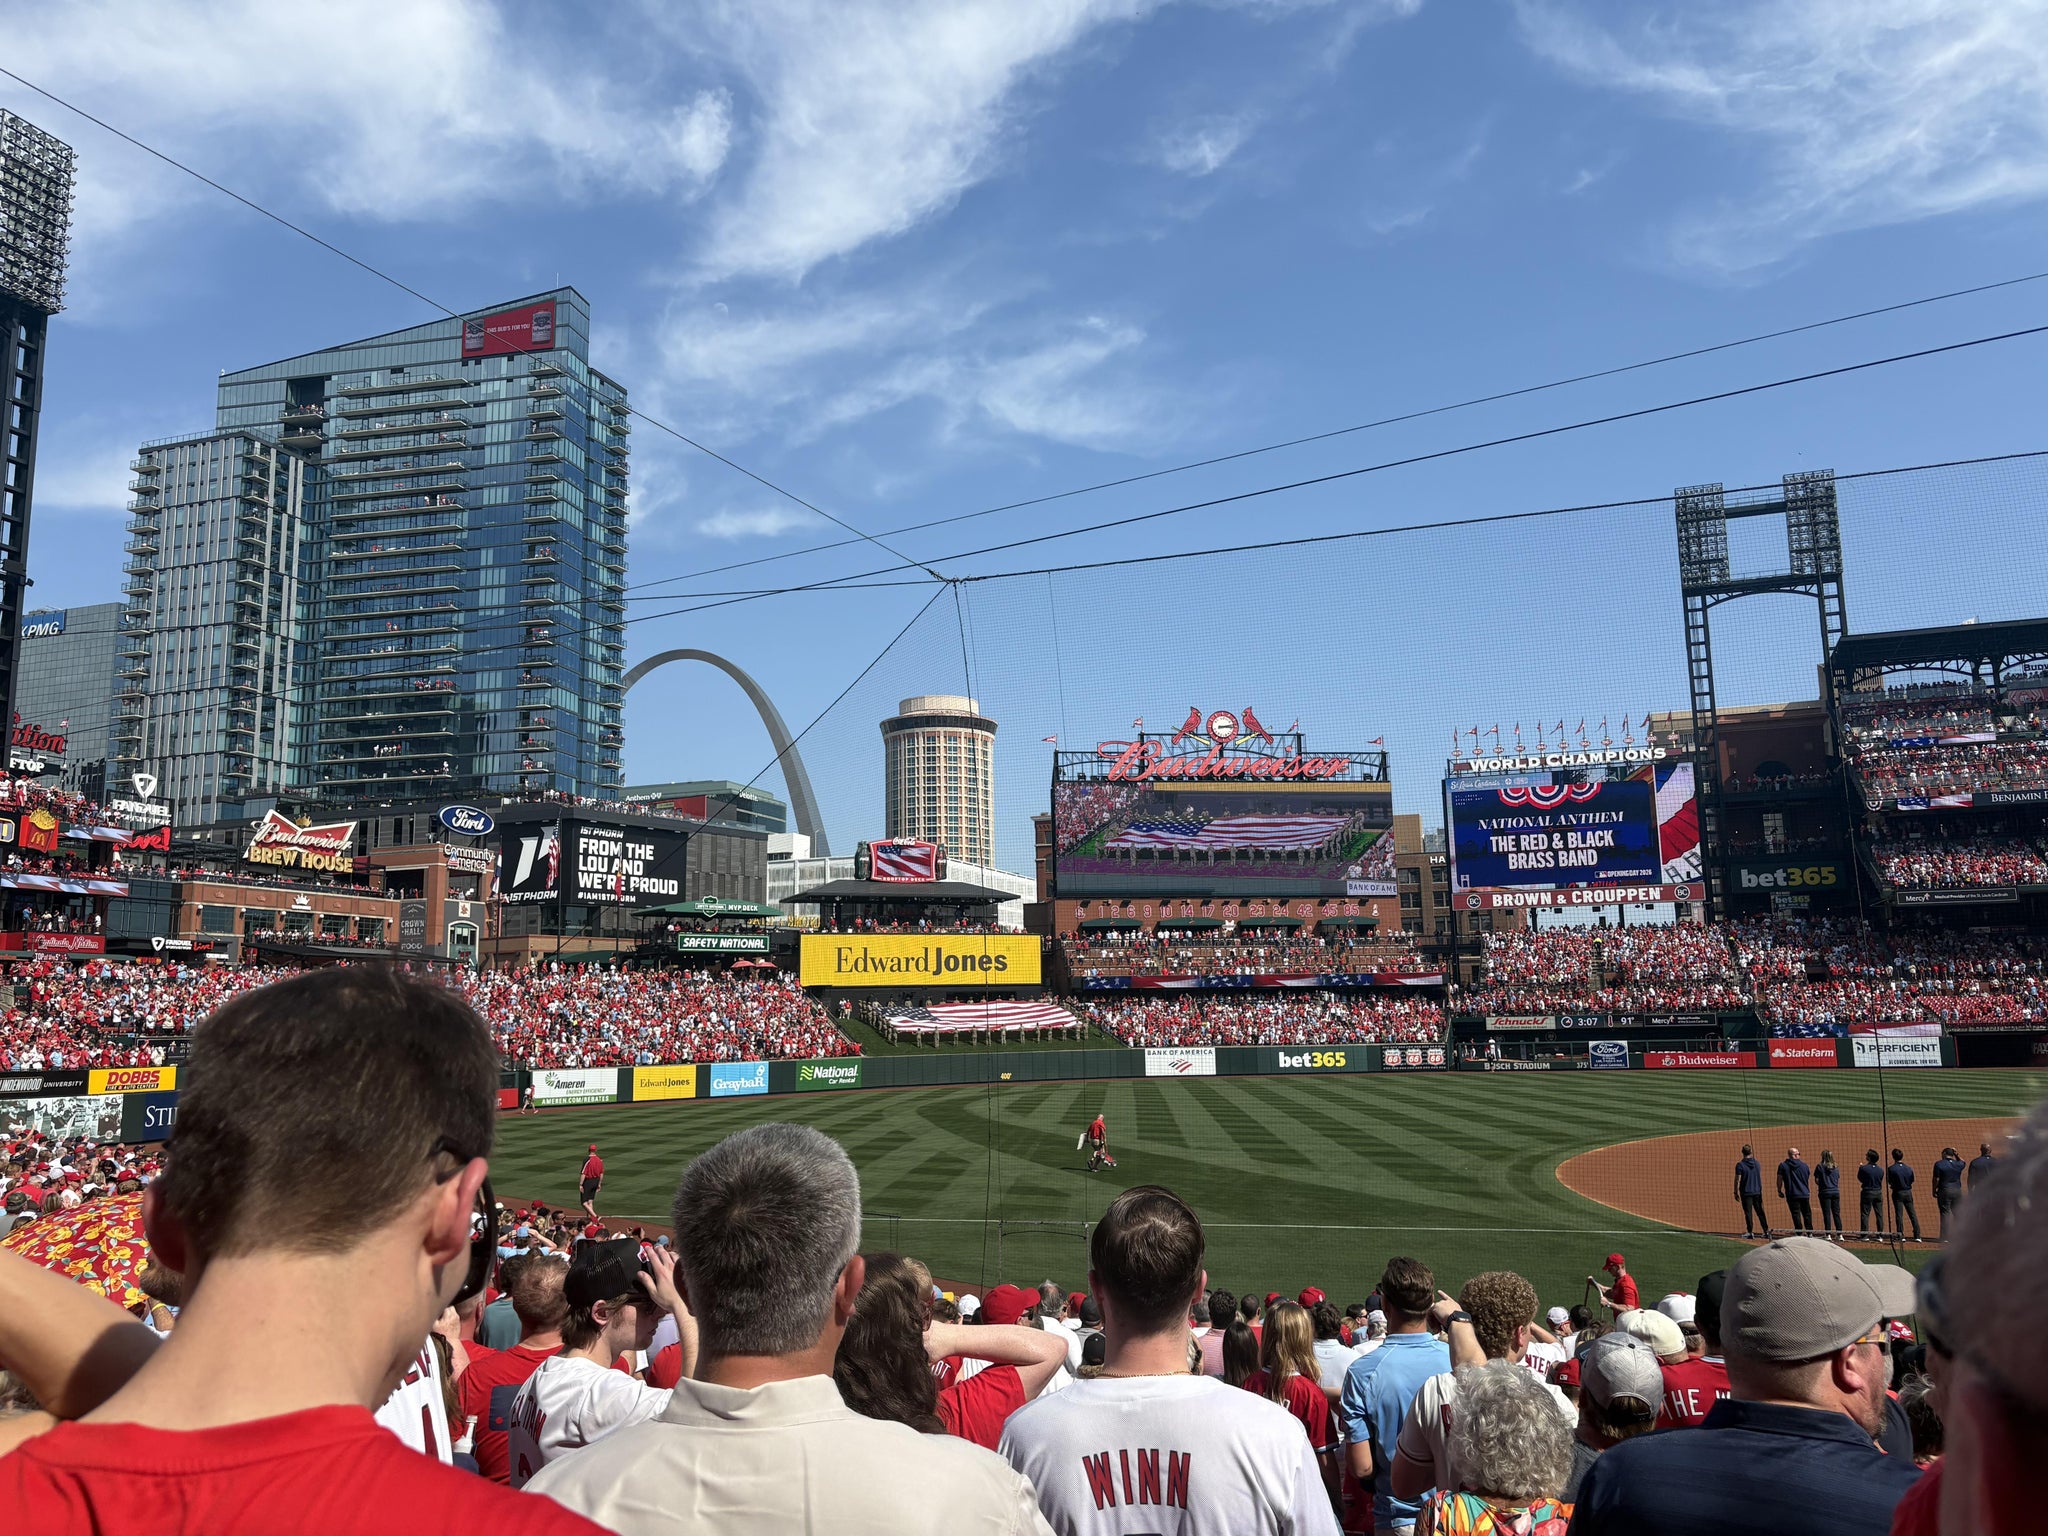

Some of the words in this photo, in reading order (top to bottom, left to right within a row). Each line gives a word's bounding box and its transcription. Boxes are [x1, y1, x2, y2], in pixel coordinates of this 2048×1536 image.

[1097, 740, 1350, 782] Budweiser
[1468, 756, 1540, 772] WORLD
[1546, 748, 1666, 766] CHAMPIONS
[1991, 791, 2041, 802] BENJAMIN
[112, 799, 172, 817] FANDUEL
[452, 808, 486, 830] Ford
[1478, 816, 1554, 830] NATIONAL
[1556, 811, 1624, 826] ANTHEM
[250, 820, 353, 850] Budweiser
[593, 828, 624, 838] PHORM
[1490, 835, 1516, 852] THE
[1520, 834, 1548, 851] RED
[1552, 833, 1564, 849] &
[1567, 830, 1614, 848] BLACK
[444, 844, 494, 862] Community
[579, 838, 622, 857] FROM
[626, 842, 654, 860] THE
[250, 846, 298, 866] BREW
[301, 852, 354, 873] HOUSE
[578, 855, 608, 872] LOU
[612, 858, 644, 876] AND
[1508, 851, 1555, 870] BRASS
[1558, 849, 1598, 867] BAND
[1740, 866, 1837, 888] bet365
[630, 876, 678, 895] PROUD
[1349, 882, 1368, 890] BANK
[1370, 882, 1380, 891] OF
[509, 893, 522, 901] 1ST
[523, 890, 558, 900] PHORM
[1492, 892, 1552, 907] BROWN
[1556, 893, 1567, 904] &
[1572, 887, 1661, 904] CROUPPEN
[1775, 895, 1810, 904] bet365
[1098, 906, 1104, 918] 1
[1111, 906, 1120, 918] 2
[1127, 905, 1136, 918] 6
[1143, 905, 1152, 917] 9
[1160, 905, 1172, 917] 10
[1181, 905, 1194, 917] 14
[1201, 905, 1215, 917] 17
[1223, 905, 1239, 917] 20
[1250, 905, 1265, 917] 23
[1273, 904, 1289, 917] 24
[1297, 904, 1313, 917] 42
[1322, 904, 1338, 917] 45
[1343, 904, 1359, 917] 85
[401, 920, 424, 928] CROWN
[683, 938, 716, 948] SAFETY
[720, 938, 765, 949] NATIONAL
[834, 946, 928, 974] Edward
[932, 947, 1008, 976] Jones
[1492, 1017, 1548, 1025] Schnucks
[1578, 1018, 1598, 1026] 3:07
[1596, 1043, 1619, 1054] Ford
[1869, 1044, 1937, 1052] PERFICIENT
[1279, 1051, 1346, 1068] bet365
[1679, 1056, 1738, 1065] Budweiser
[107, 1070, 160, 1084] DOBBS
[813, 1064, 858, 1078] National
[0, 1078, 42, 1092] LINDENWOOD
[44, 1080, 84, 1088] UNIVERSITY
[554, 1080, 585, 1089] Ameren
[640, 1078, 667, 1088] Edward
[667, 1078, 690, 1087] Jones
[542, 1095, 609, 1105] AMEREN.COM/REBATES
[1082, 1448, 1191, 1510] WINN
